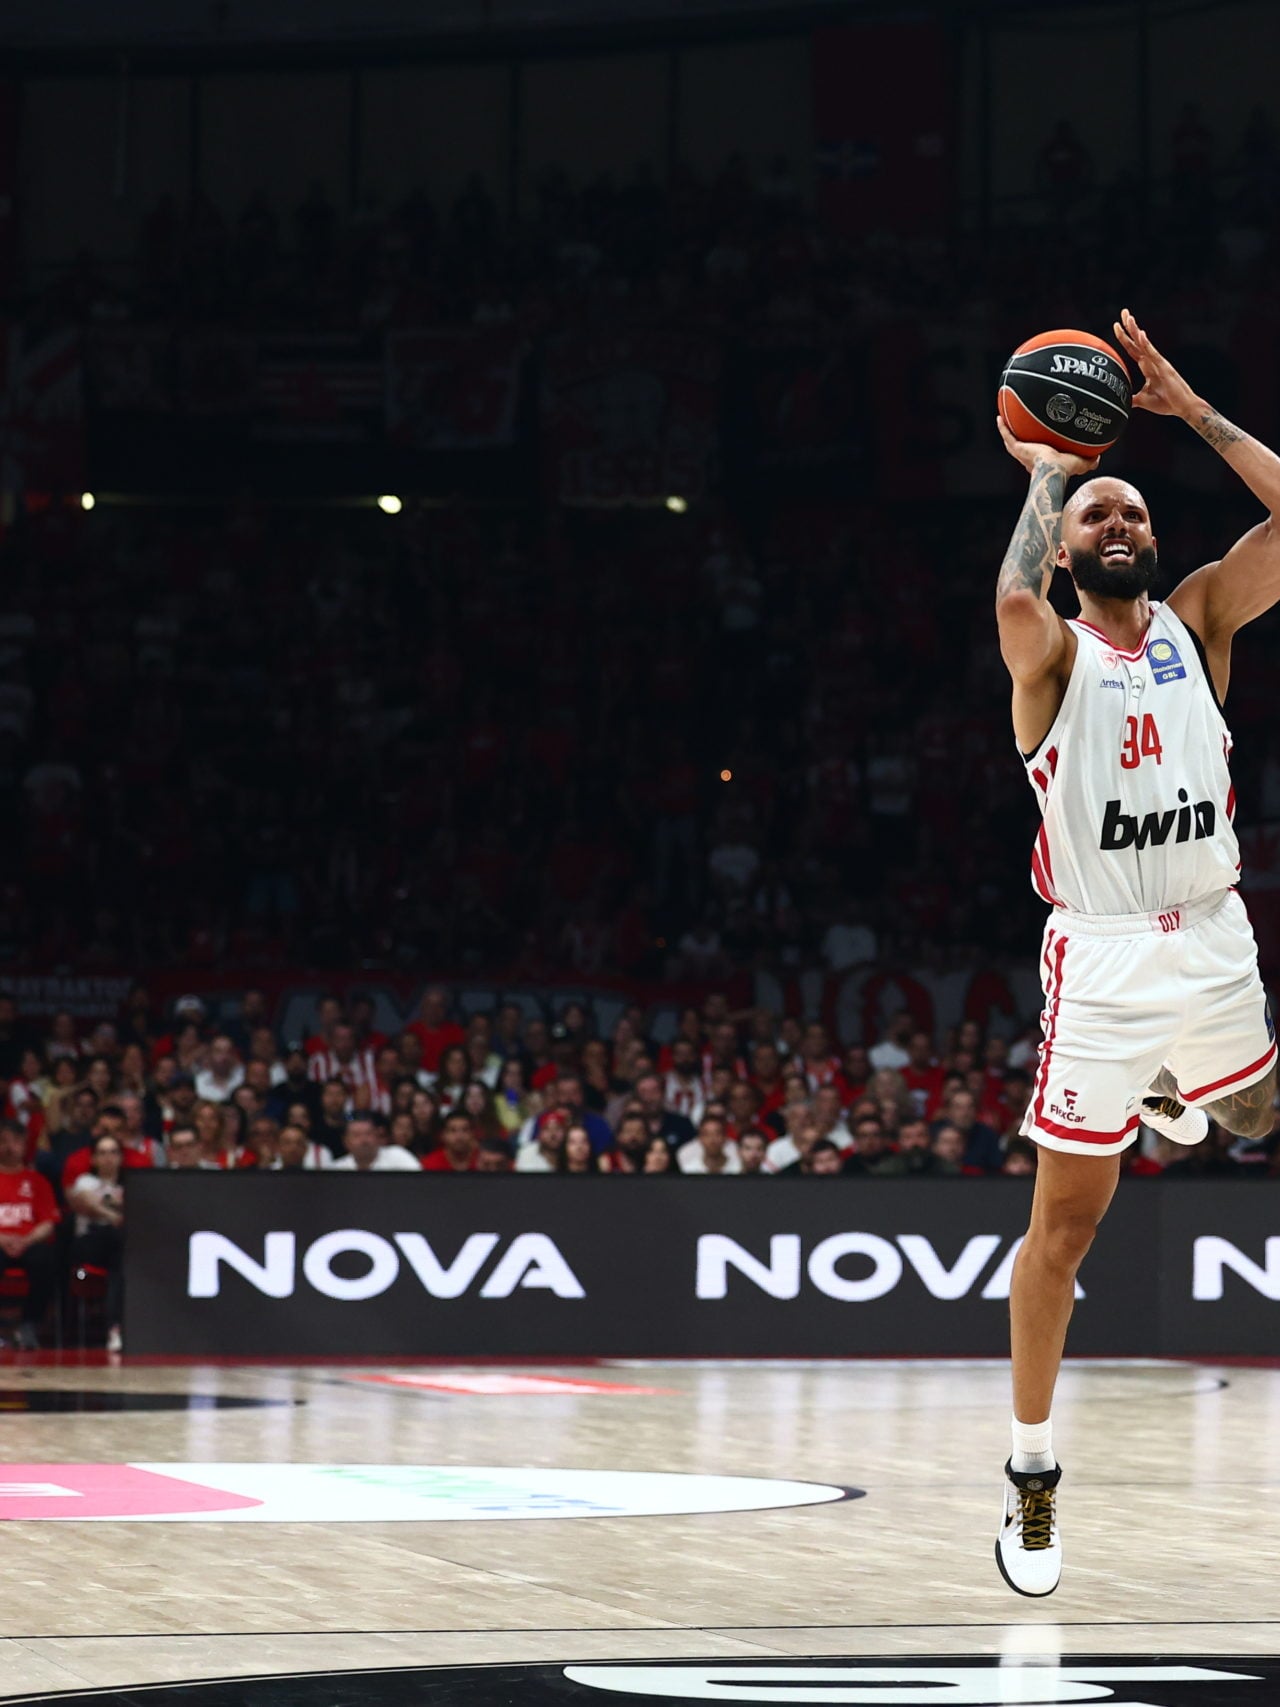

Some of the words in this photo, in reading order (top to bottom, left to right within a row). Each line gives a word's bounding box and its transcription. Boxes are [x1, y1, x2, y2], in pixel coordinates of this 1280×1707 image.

[1120, 713, 1163, 770] 34
[1099, 787, 1216, 850] bwin
[1157, 908, 1181, 933] OLY
[1050, 1103, 1087, 1123] FlexCar
[187, 1228, 587, 1301] NOVA
